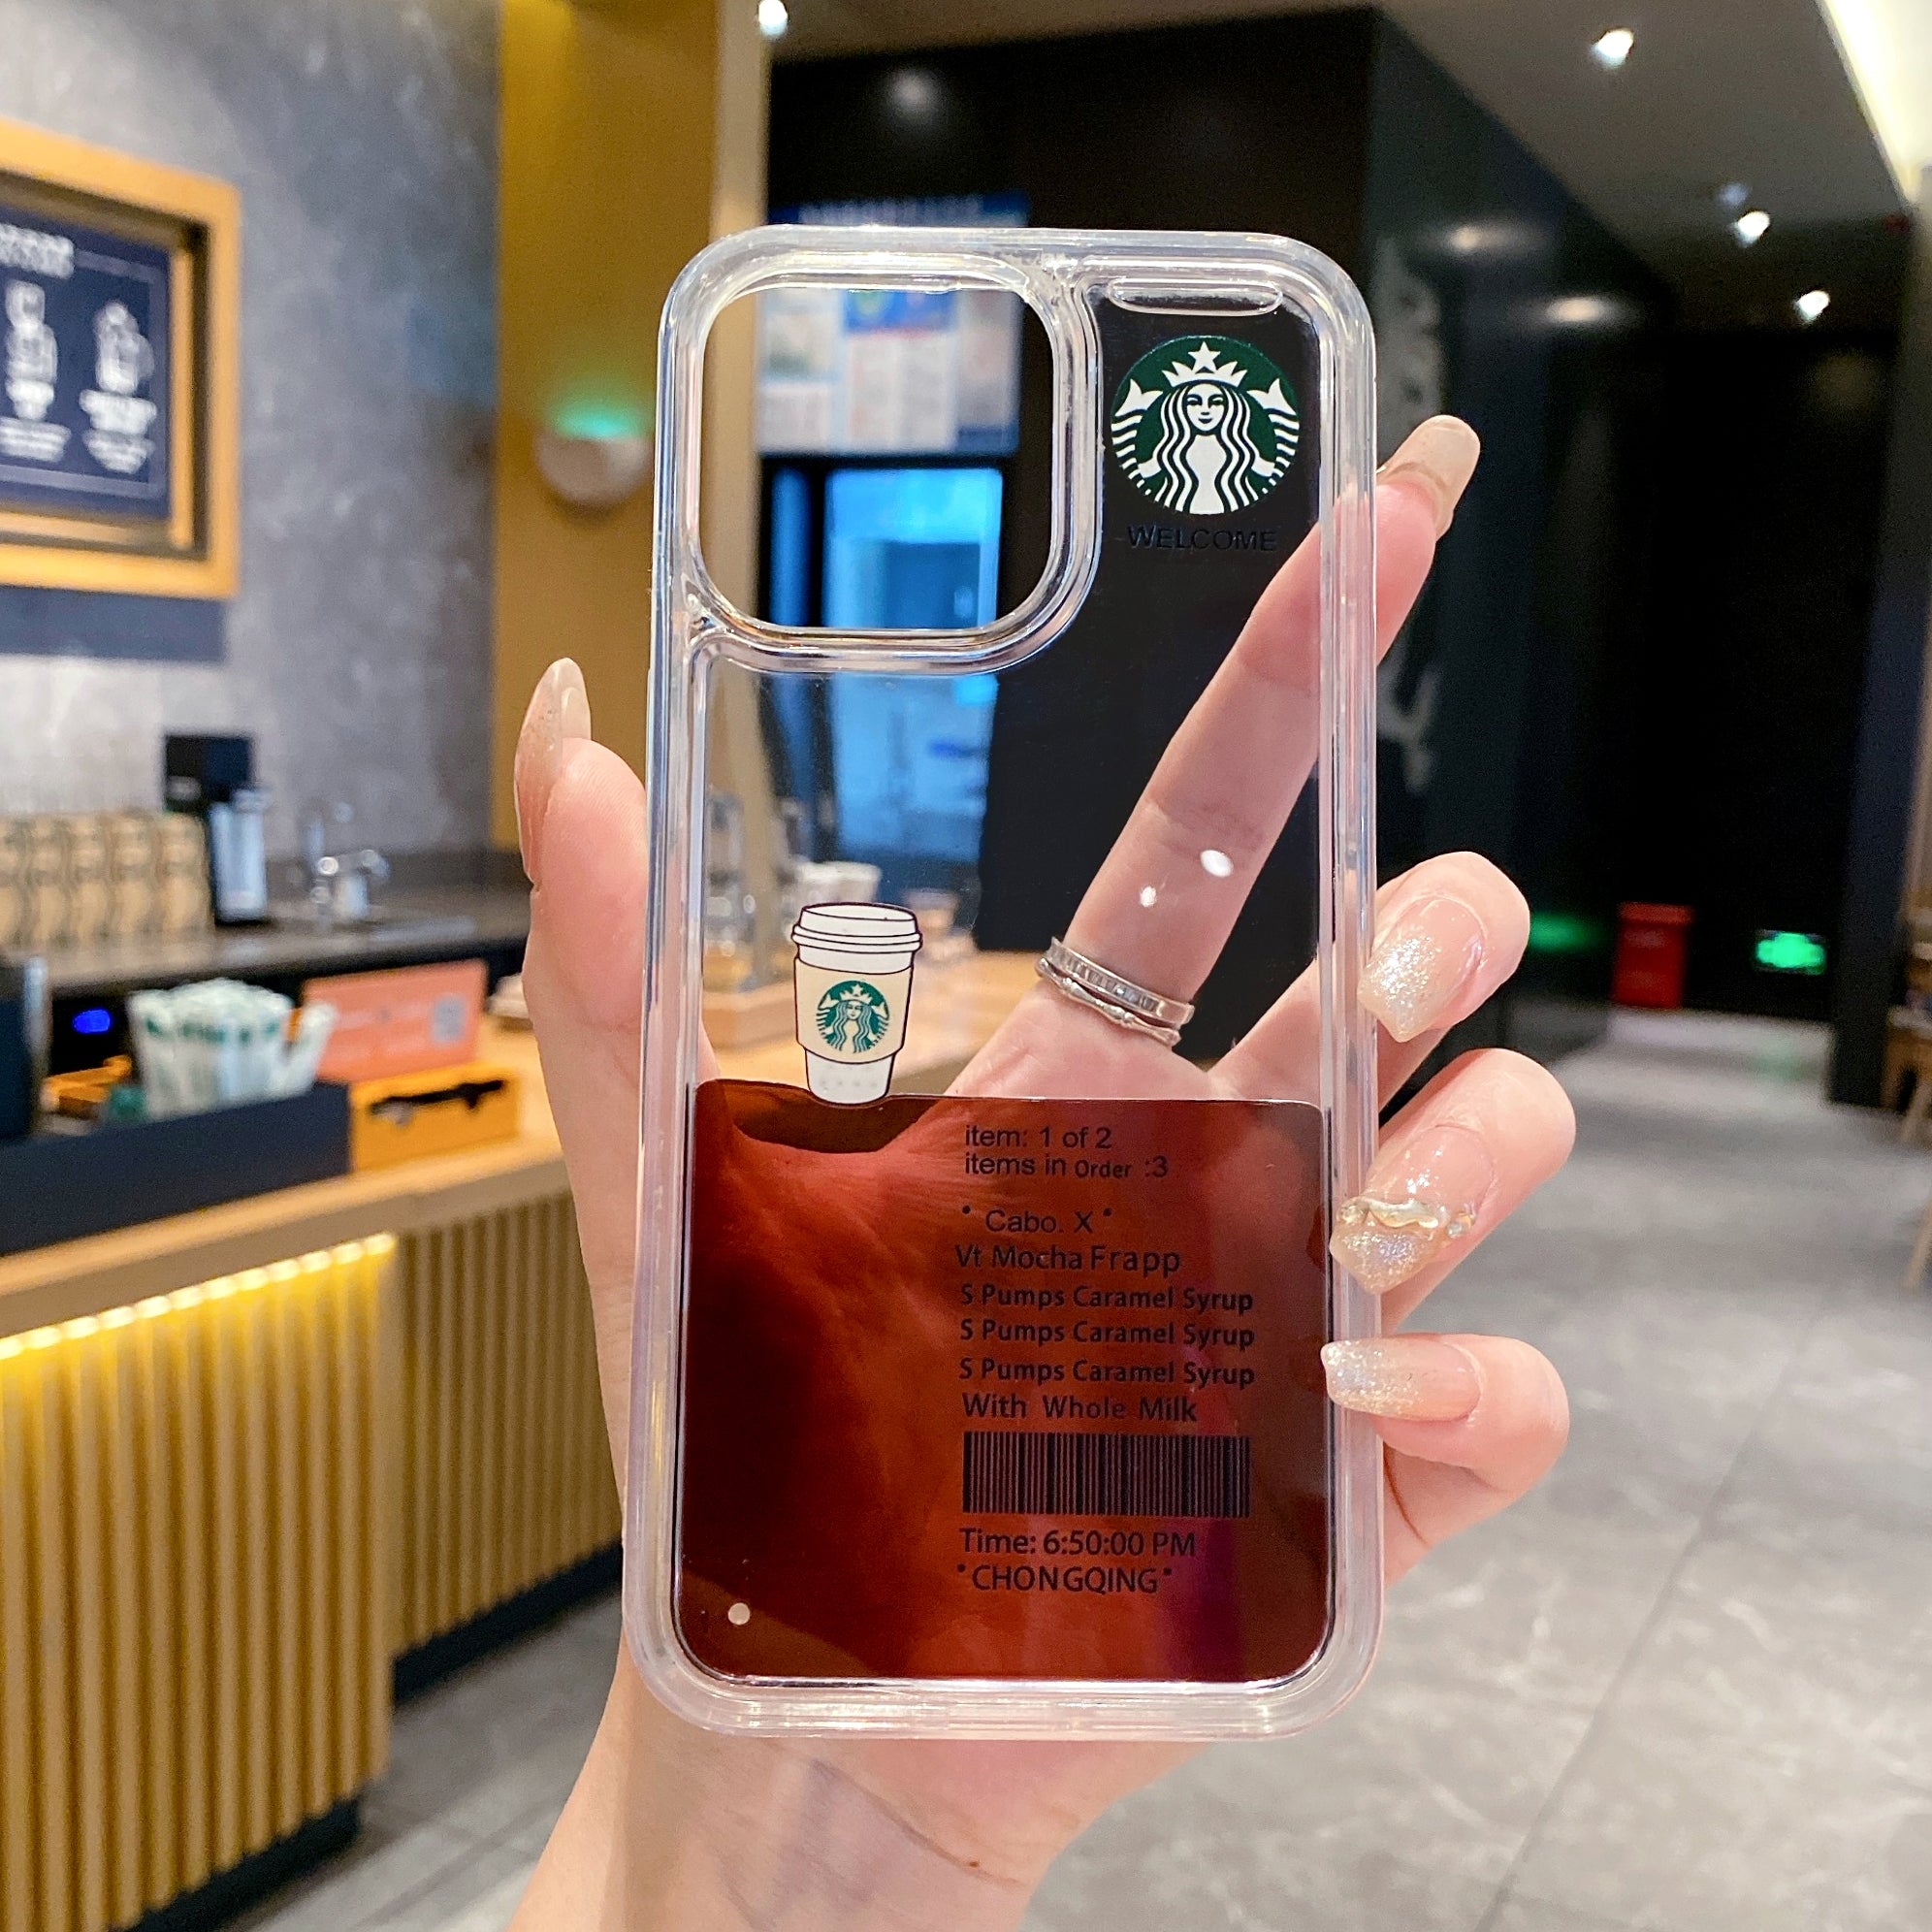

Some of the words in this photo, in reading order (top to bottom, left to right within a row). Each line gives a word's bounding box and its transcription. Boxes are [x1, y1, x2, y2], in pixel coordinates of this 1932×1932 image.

[1127, 524, 1277, 551] WELCOME
[965, 1125, 1028, 1147] item:
[1040, 1127, 1051, 1147] 1
[1062, 1127, 1089, 1148] of
[1095, 1127, 1112, 1148] 2
[965, 1152, 1036, 1175] items
[1045, 1153, 1066, 1175] in
[1075, 1159, 1133, 1178] Order
[1074, 1211, 1094, 1233] X
[992, 1244, 1082, 1270] Mocha
[1090, 1245, 1181, 1278] Frapp
[982, 1283, 1064, 1309] Pumps
[1073, 1285, 1175, 1308] Caramel
[1182, 1288, 1253, 1315] Syrup
[982, 1318, 1064, 1345] Pumps
[1073, 1320, 1175, 1343] Caramel
[1183, 1322, 1254, 1350] Syrup
[982, 1357, 1064, 1386] Pumps
[1073, 1358, 1175, 1382] Caramel
[1183, 1361, 1255, 1390] Syrup
[963, 1393, 1026, 1418] With
[1043, 1395, 1125, 1419] Whole
[1139, 1396, 1198, 1422] Milk
[959, 1528, 1037, 1554] Time:
[1043, 1530, 1144, 1557] 6:50:00
[1152, 1532, 1198, 1557] PM
